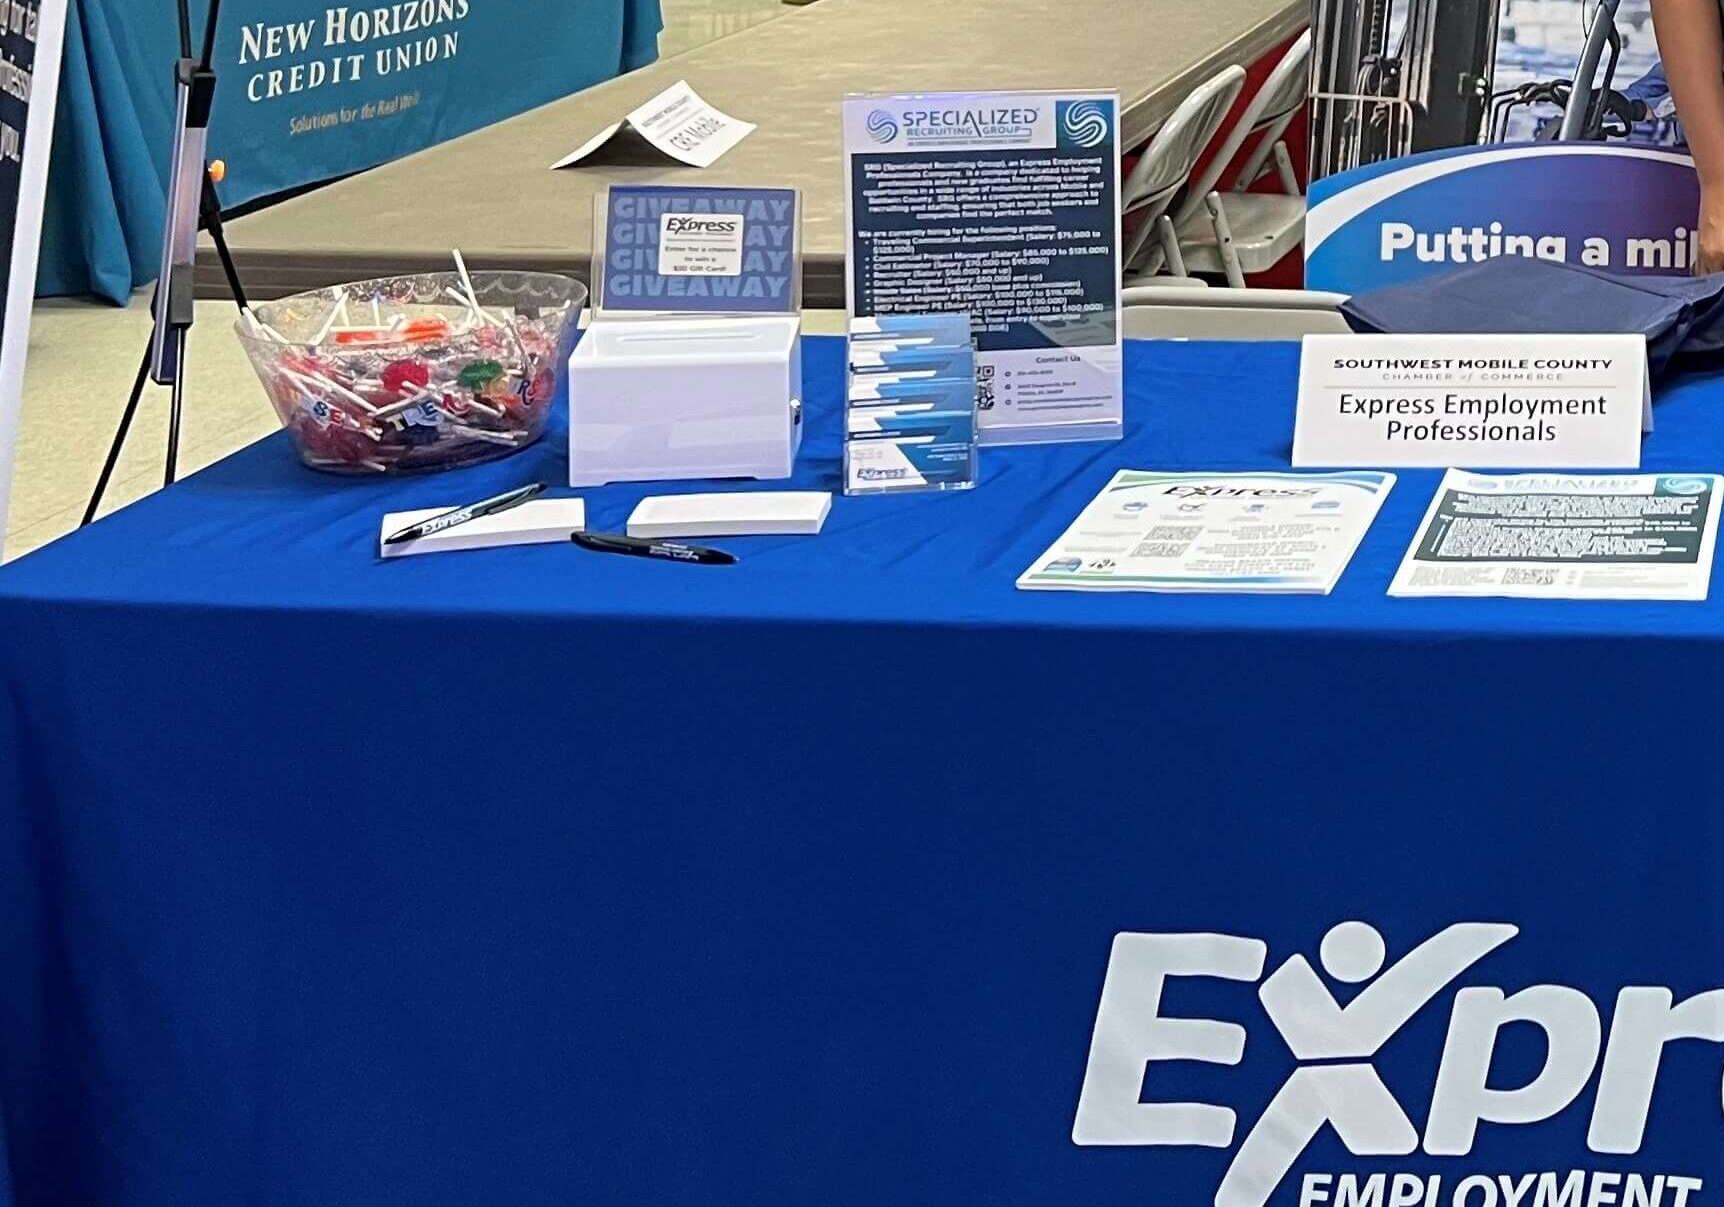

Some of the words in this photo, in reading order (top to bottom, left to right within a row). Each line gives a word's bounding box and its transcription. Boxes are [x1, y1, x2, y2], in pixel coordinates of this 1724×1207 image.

[238, 19, 315, 64] NEW
[247, 54, 365, 102] CREDIT
[376, 31, 459, 75] UNION
[902, 108, 1038, 127] SPECIALIZED
[666, 217, 737, 235] Express
[1581, 237, 1609, 266] a
[609, 275, 788, 298] GIVEAWAY
[1333, 359, 1453, 370] SOUTHWEST
[1457, 359, 1529, 370] MOBILE
[1533, 359, 1613, 370] COUNTY
[1382, 372, 1453, 381] CHAMBER
[1480, 372, 1564, 381] COMMERCE
[1339, 394, 1434, 419] Express
[1444, 394, 1607, 422] Employment
[1387, 419, 1556, 442] Professionals
